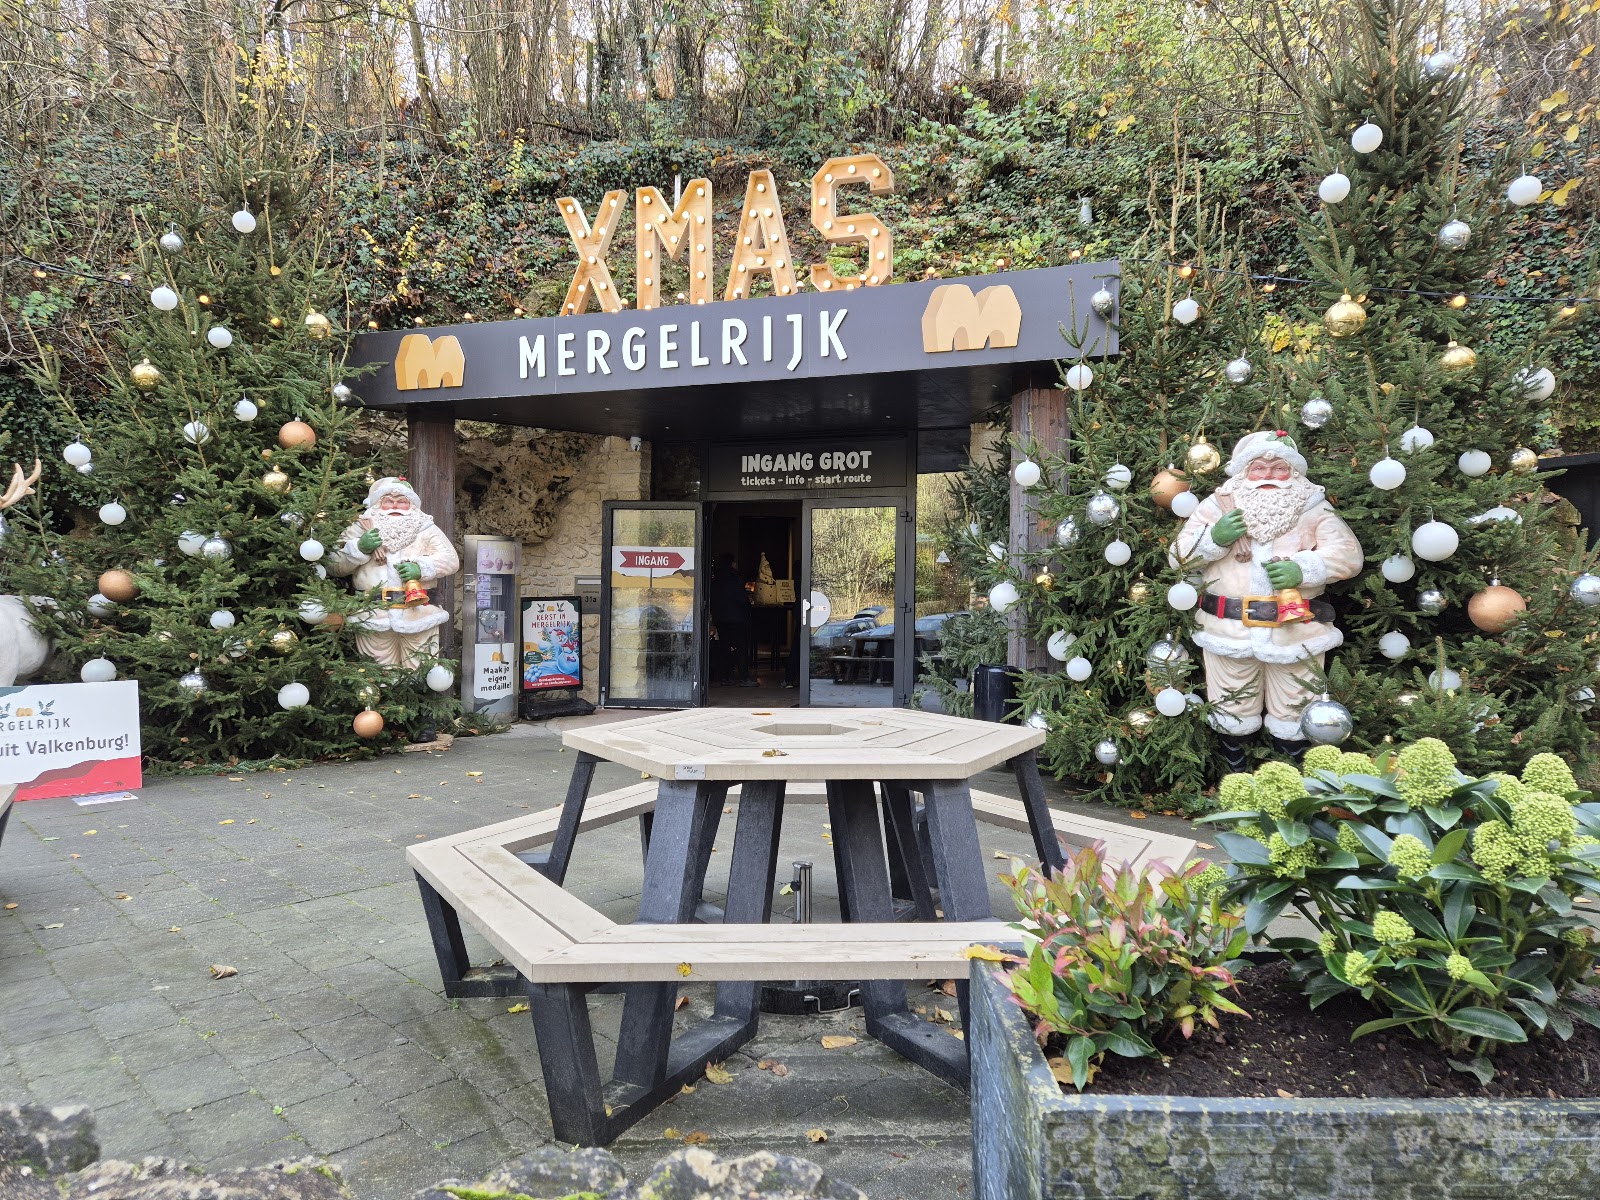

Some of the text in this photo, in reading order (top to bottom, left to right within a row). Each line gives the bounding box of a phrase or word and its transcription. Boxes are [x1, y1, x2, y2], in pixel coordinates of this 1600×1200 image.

[555, 153, 894, 316] XMAS
[519, 309, 849, 379] MERGELRIJK
[741, 450, 873, 473] INGANG GROT
[740, 476, 776, 486] tickets
[785, 475, 805, 485] info
[815, 474, 842, 484] start
[843, 473, 872, 483] route
[635, 555, 669, 566] INGANG
[483, 666, 510, 674] Maak je
[487, 675, 507, 683] eigen
[480, 682, 512, 691] medaille!
[26, 733, 129, 755] Valkenburg!
